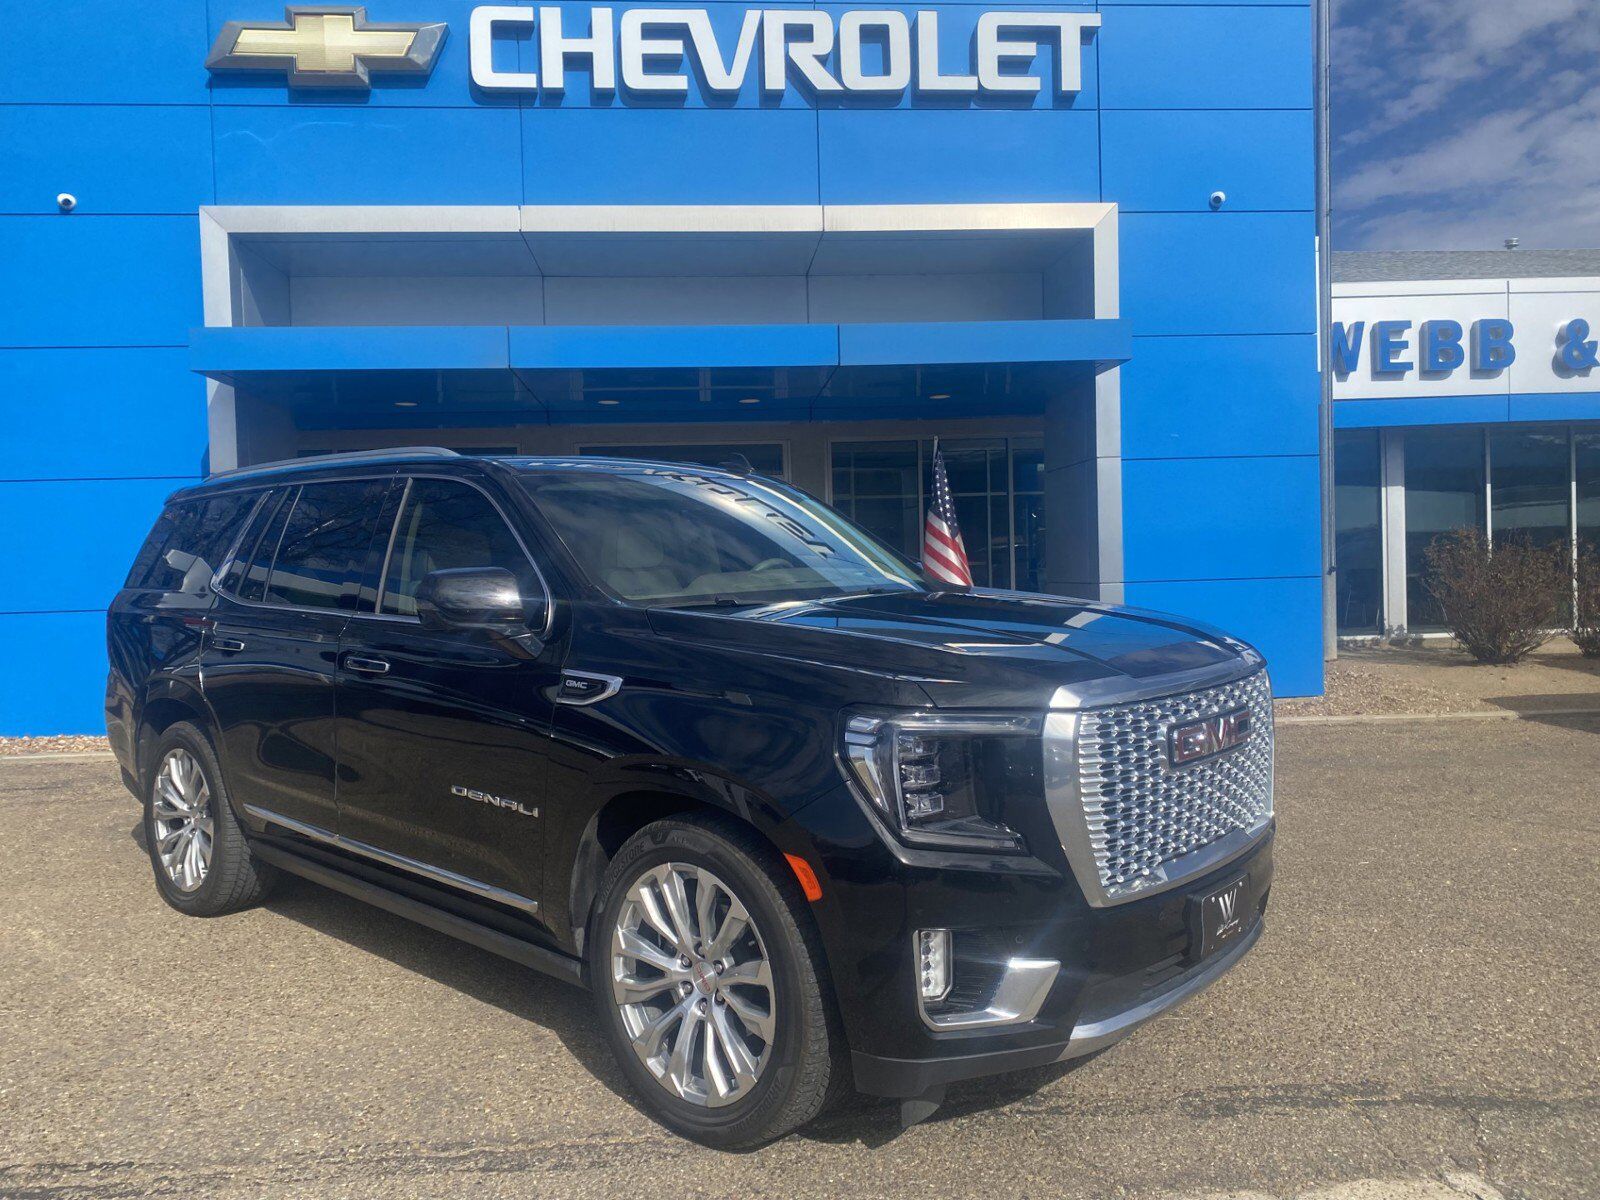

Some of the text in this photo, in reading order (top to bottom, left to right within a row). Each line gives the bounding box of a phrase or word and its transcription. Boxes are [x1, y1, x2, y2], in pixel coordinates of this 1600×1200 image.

[470, 6, 1102, 92] CHEVROLET
[1557, 318, 1600, 370] &
[565, 679, 588, 689] GMC
[1174, 711, 1250, 763] GMC
[450, 784, 539, 818] DENALI
